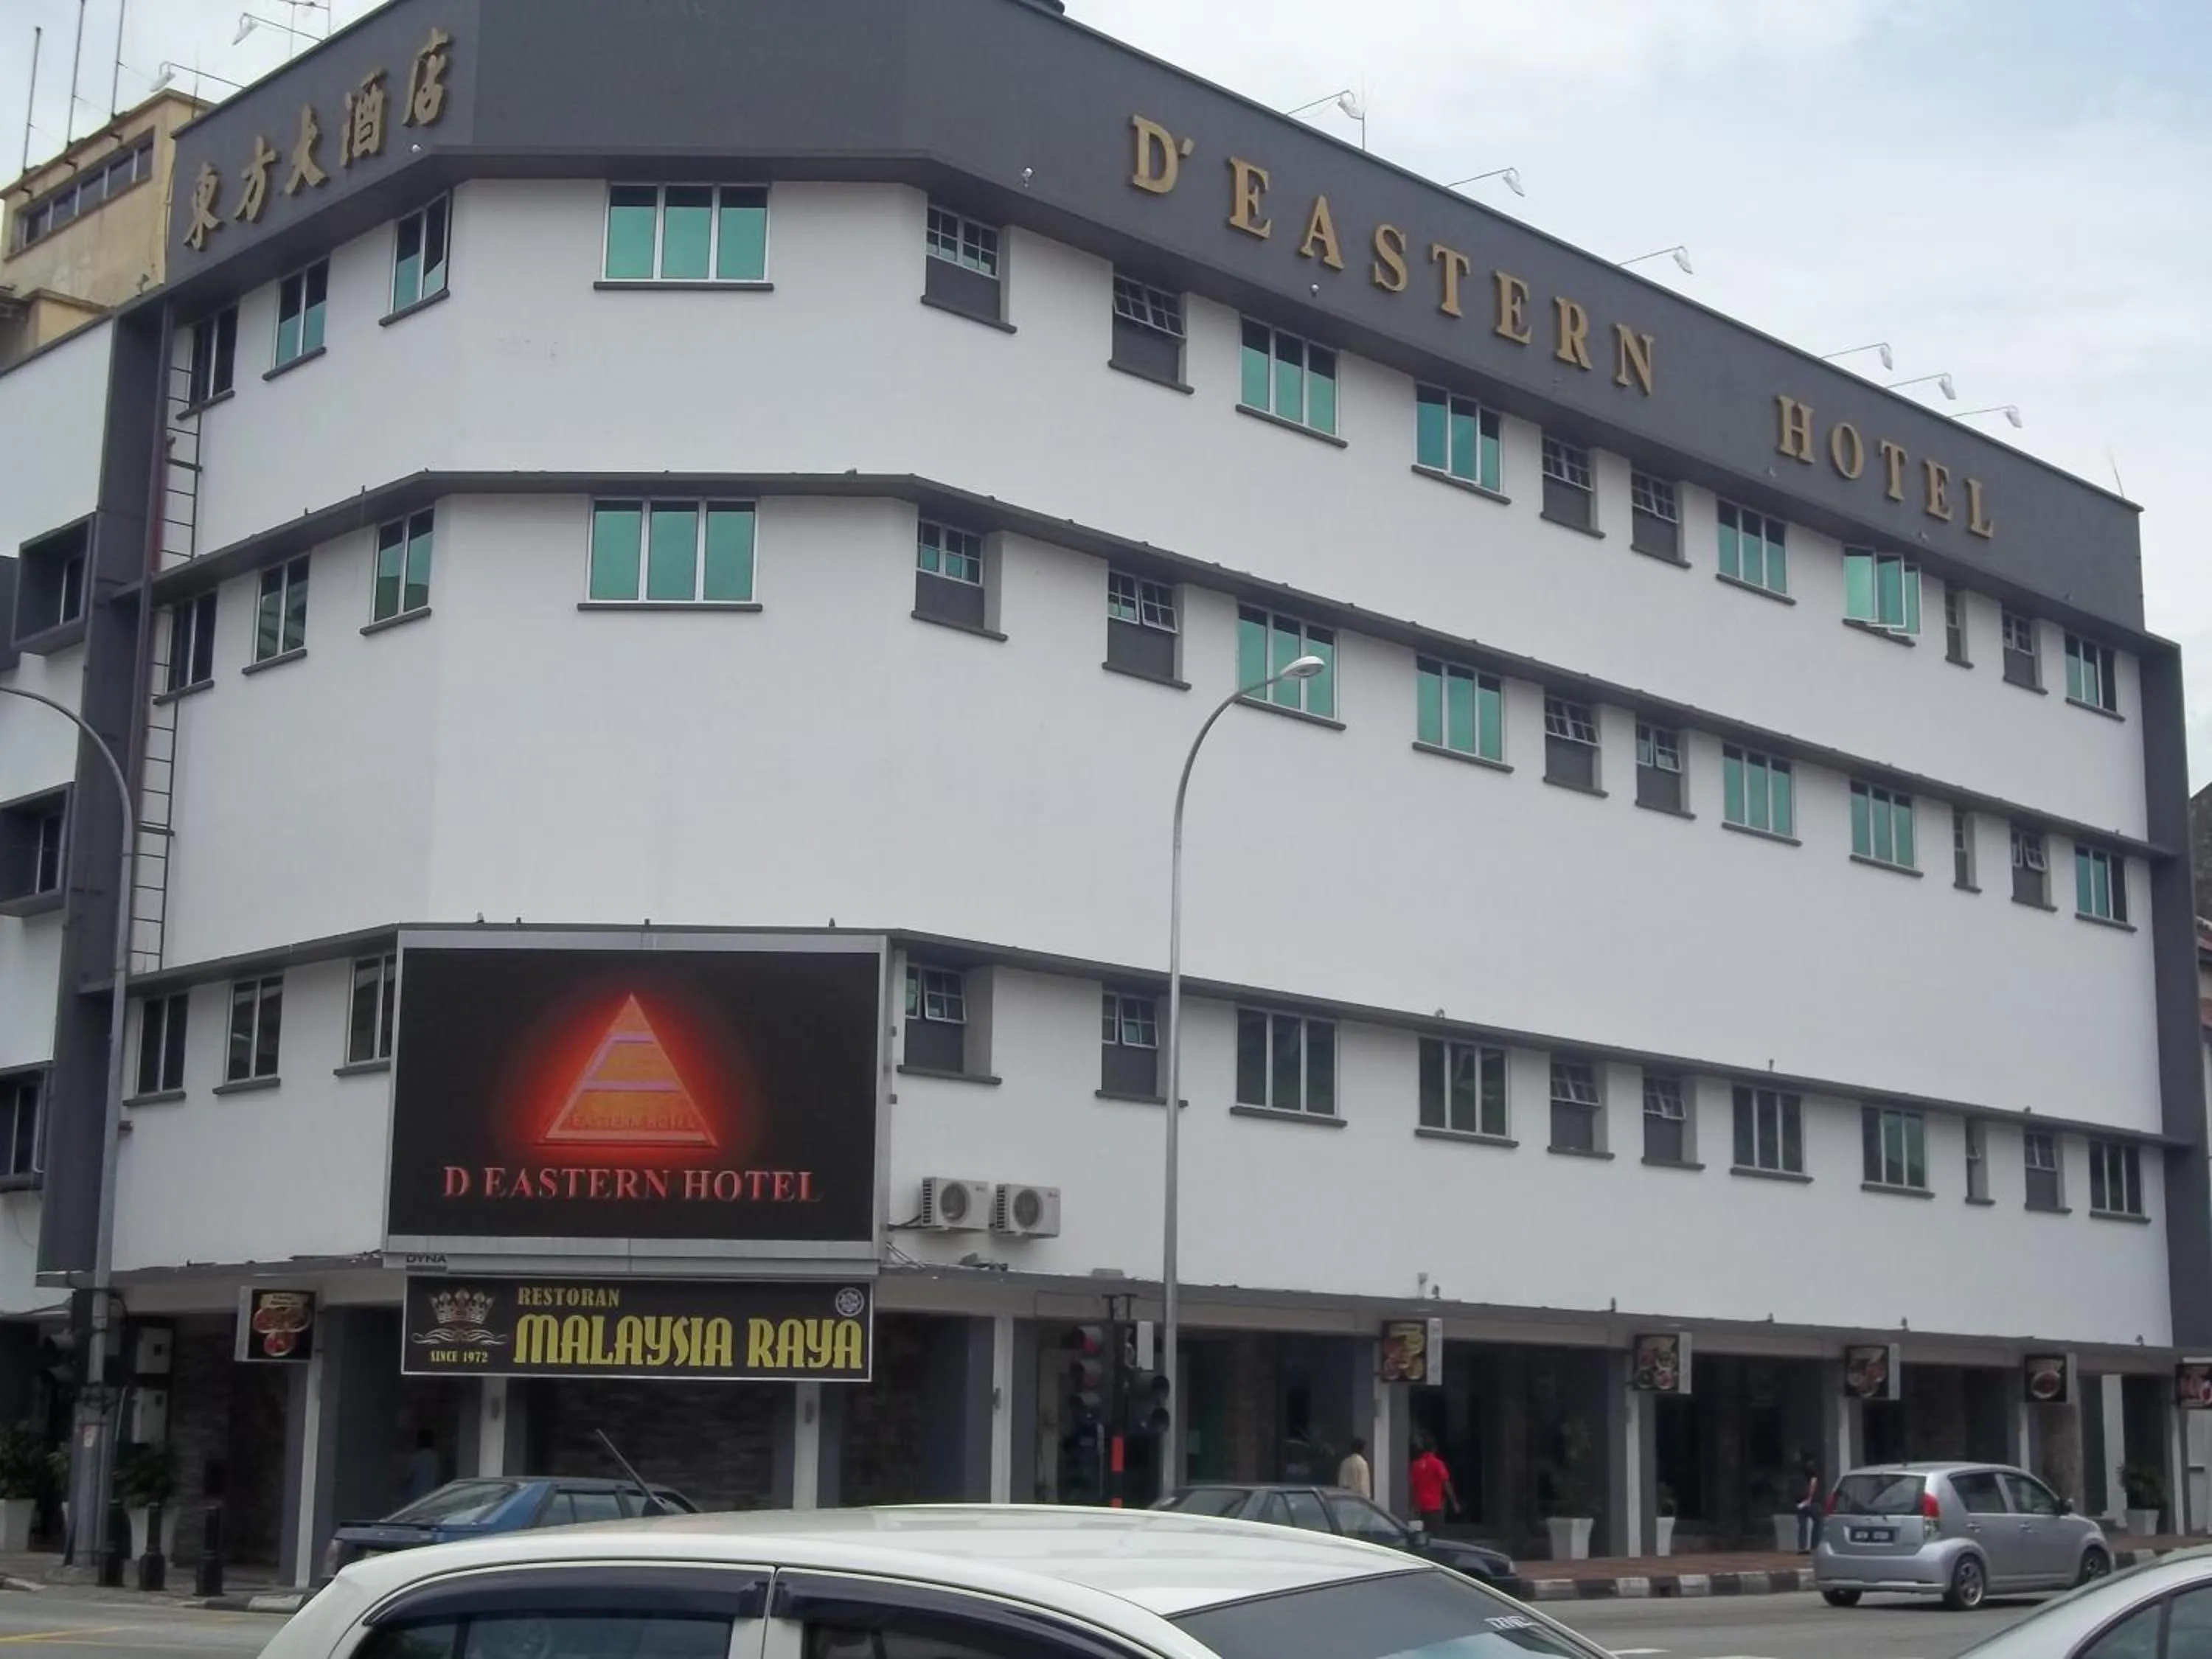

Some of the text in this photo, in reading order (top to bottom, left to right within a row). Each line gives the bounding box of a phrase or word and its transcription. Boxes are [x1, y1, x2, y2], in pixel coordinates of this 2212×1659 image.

[183, 27, 451, 250] 東方大酒店
[1775, 394, 1995, 538] HOTEL
[442, 1166, 821, 1203] D EASTERN HOTEL
[406, 1253, 447, 1263] DYNA
[517, 1287, 620, 1307] RESTORAN
[430, 1350, 488, 1363] SINCE 1972
[513, 1315, 863, 1369] MALAYSIA RAYA
